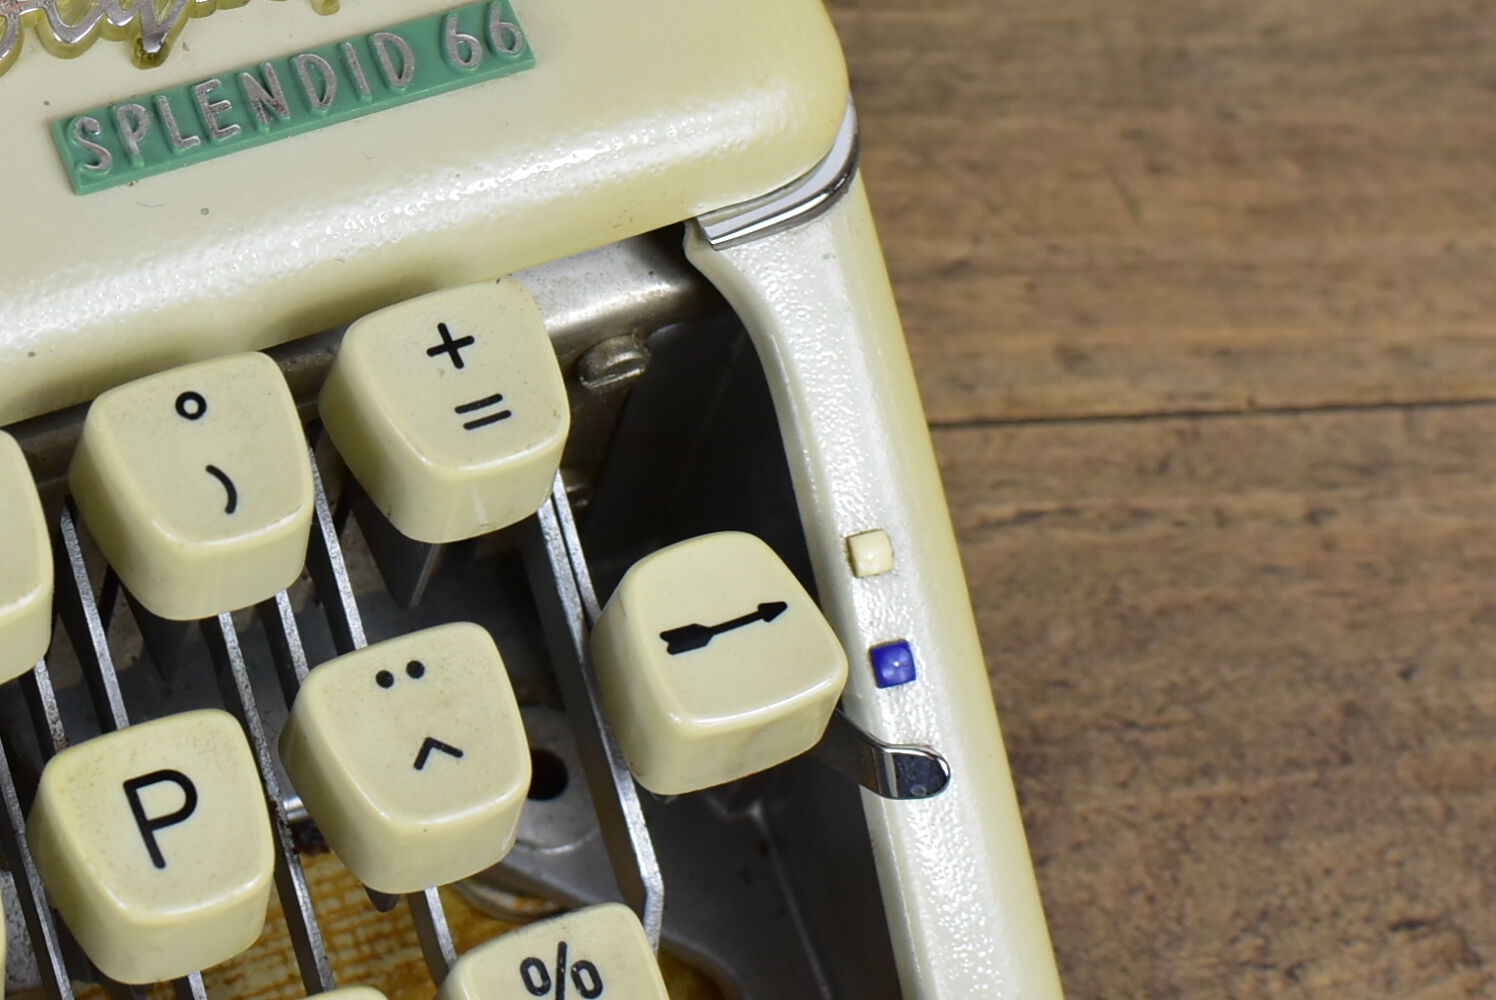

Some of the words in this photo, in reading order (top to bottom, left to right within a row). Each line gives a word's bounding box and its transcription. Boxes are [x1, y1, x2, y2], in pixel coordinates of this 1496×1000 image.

[67, 30, 416, 174] SPLENDID
[443, 0, 524, 71] 66
[121, 768, 199, 871] P
